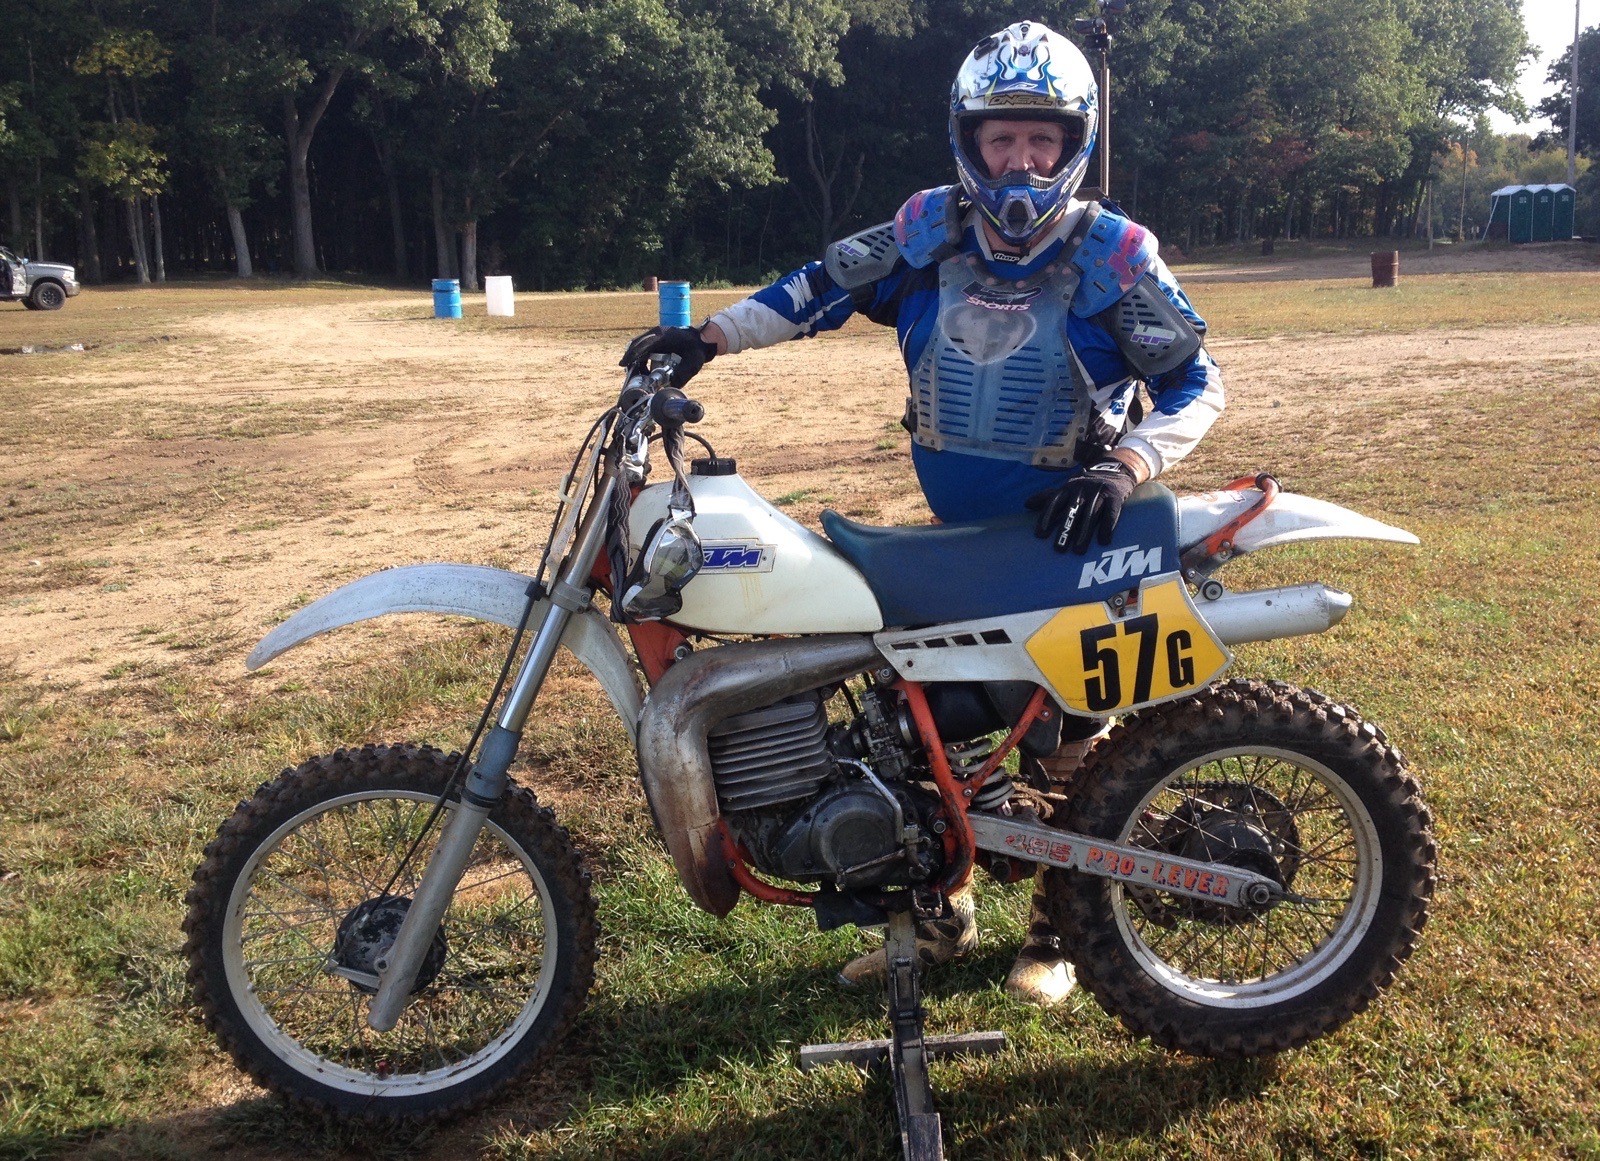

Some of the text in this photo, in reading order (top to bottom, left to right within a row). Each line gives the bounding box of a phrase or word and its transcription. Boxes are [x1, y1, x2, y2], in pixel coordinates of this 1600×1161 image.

[966, 296, 1031, 311] SPORTS
[702, 545, 763, 569] TM
[1078, 544, 1162, 589] KTM
